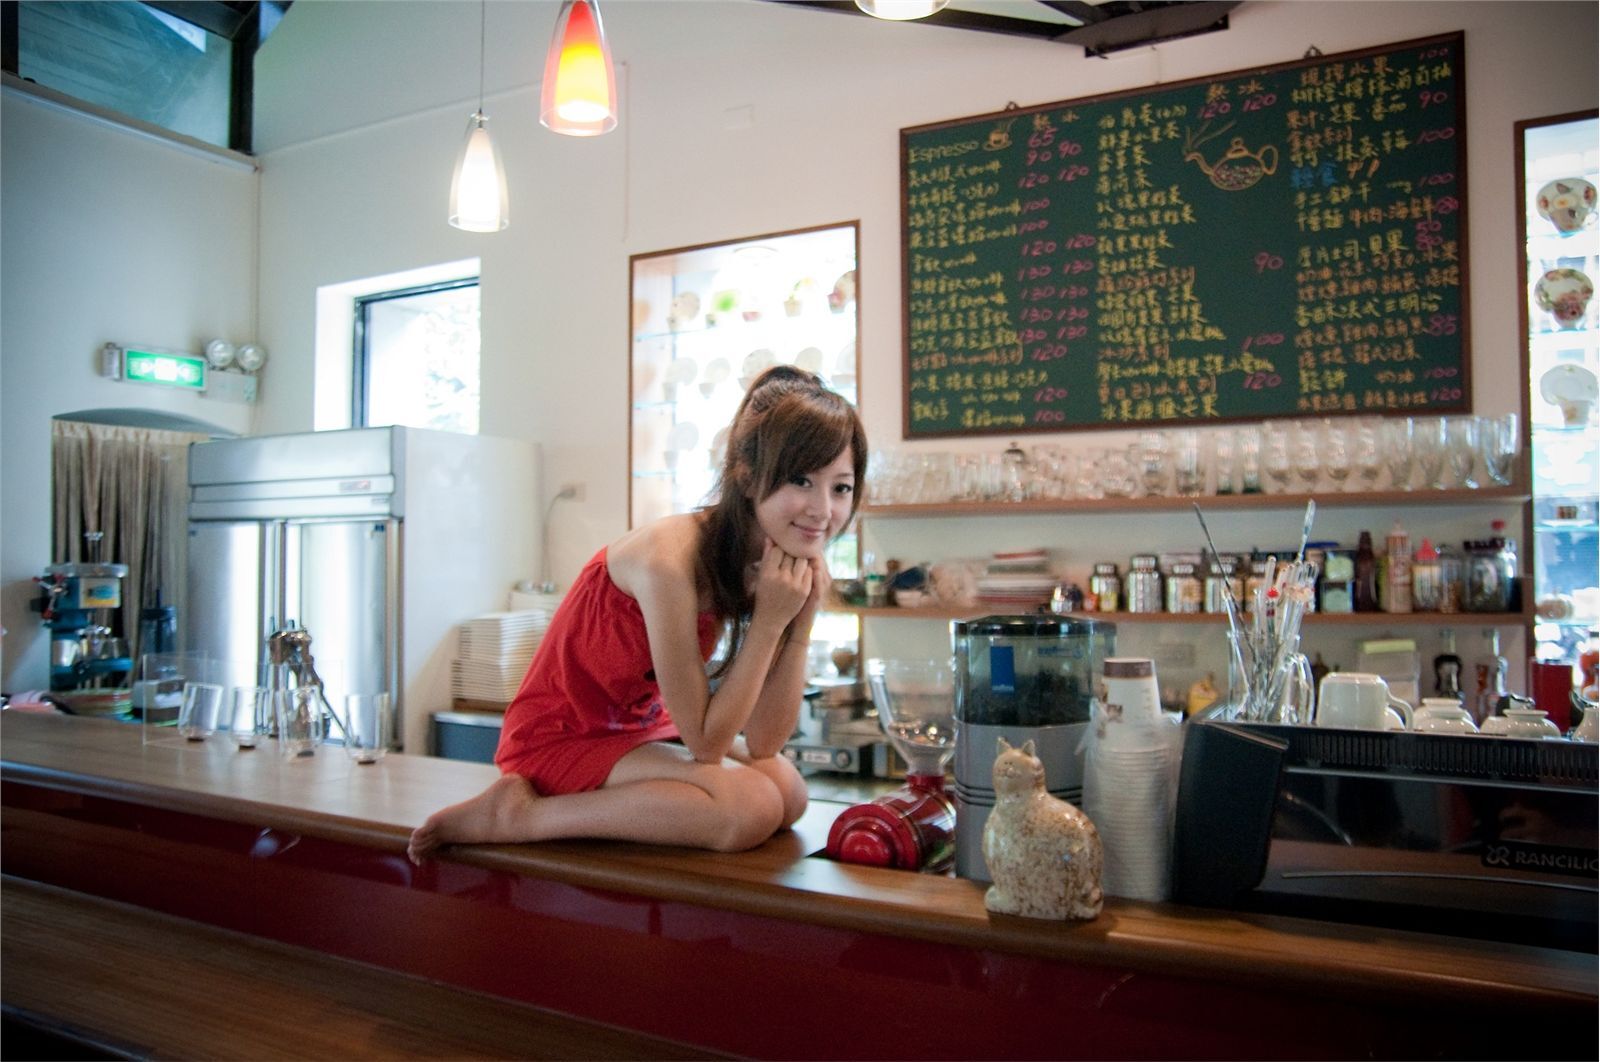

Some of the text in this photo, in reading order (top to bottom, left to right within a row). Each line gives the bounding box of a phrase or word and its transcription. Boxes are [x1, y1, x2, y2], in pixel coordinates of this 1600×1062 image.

[1199, 101, 1231, 119] 120
[1242, 93, 1277, 112] 120
[1419, 91, 1448, 109] 90
[1028, 127, 1058, 148] 65
[1416, 127, 1455, 144] 100
[908, 141, 979, 163] Espresso
[1027, 141, 1082, 166] 90 90
[1018, 173, 1049, 189] 120
[1059, 165, 1090, 181] 120
[1419, 172, 1454, 187] 100
[1023, 199, 1050, 213] 100
[1019, 220, 1049, 235] 100
[1022, 234, 1096, 257] 120 120
[1018, 261, 1094, 282] 130 130
[1255, 251, 1284, 274] 90
[1021, 285, 1055, 300] 130
[1059, 286, 1089, 298] 130
[1020, 308, 1053, 323] 130
[1056, 307, 1089, 321] 130
[1019, 329, 1048, 344] 130
[1057, 325, 1088, 340] 130
[1241, 332, 1285, 351] 100
[1031, 343, 1068, 361] 120
[1244, 372, 1281, 390] 120
[1034, 387, 1069, 403] 120
[1035, 409, 1066, 425] 100
